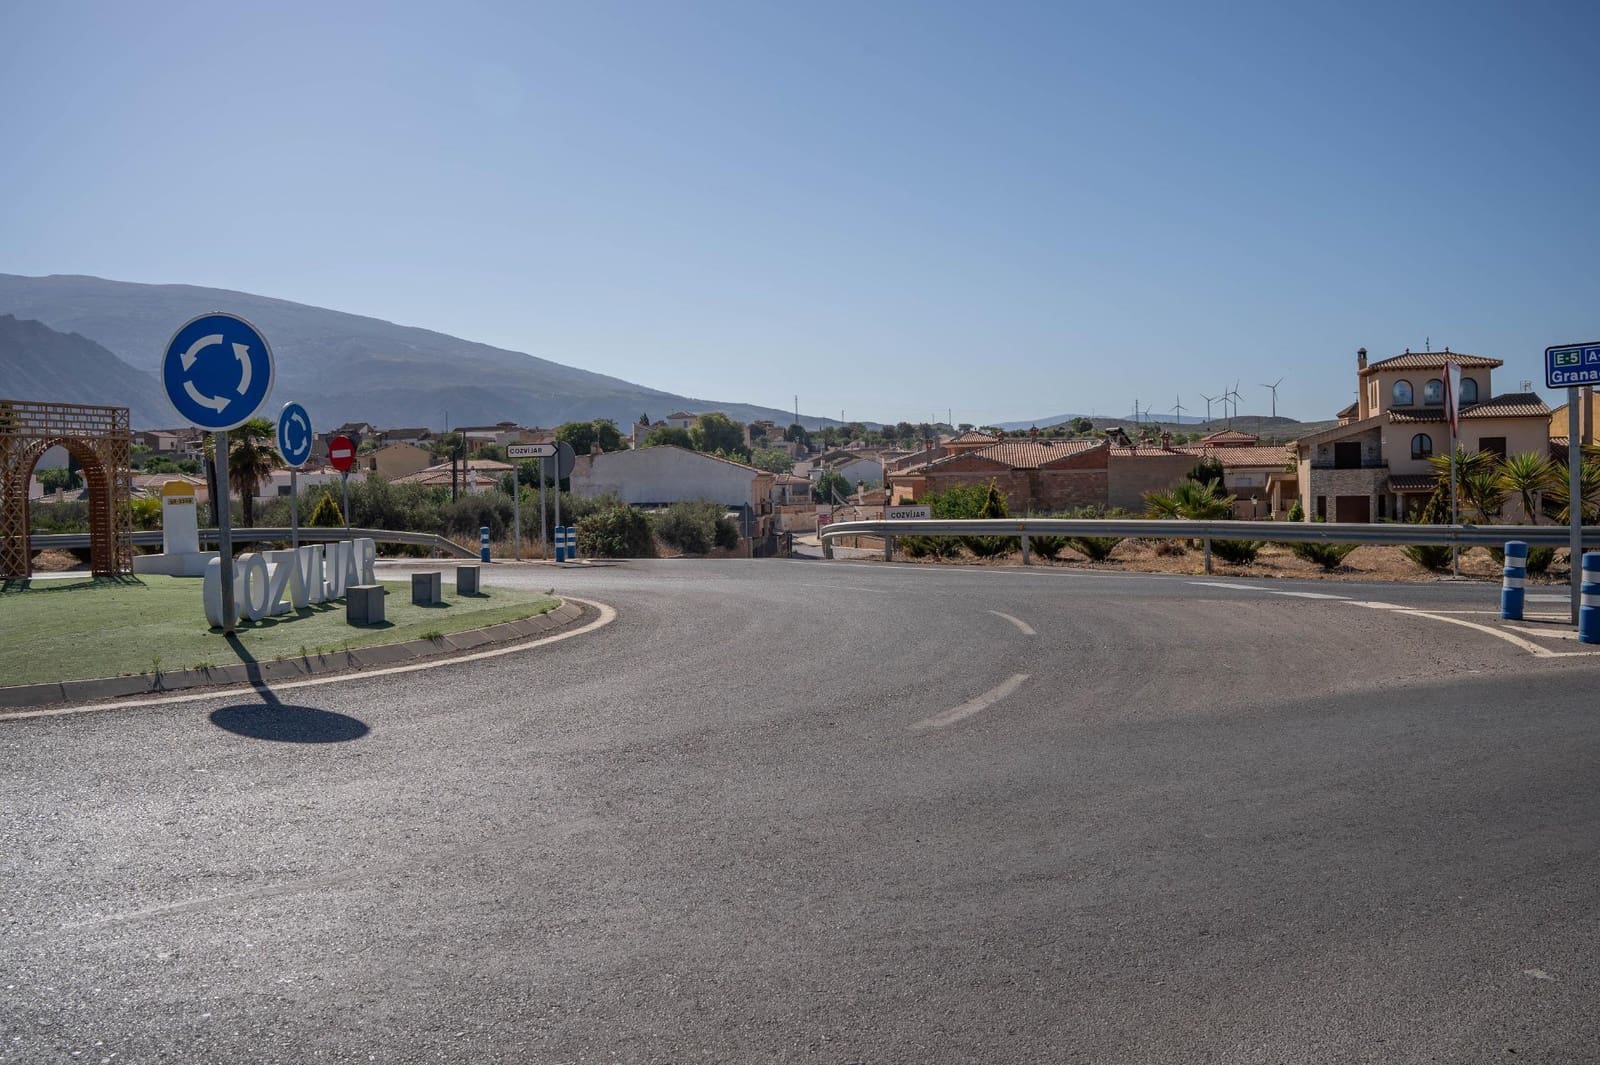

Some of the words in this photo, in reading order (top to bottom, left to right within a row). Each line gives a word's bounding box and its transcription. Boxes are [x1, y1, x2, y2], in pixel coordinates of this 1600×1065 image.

[1557, 352, 1578, 364] E-5
[1552, 370, 1600, 382] Grana
[890, 510, 925, 519] COZVÍJAR
